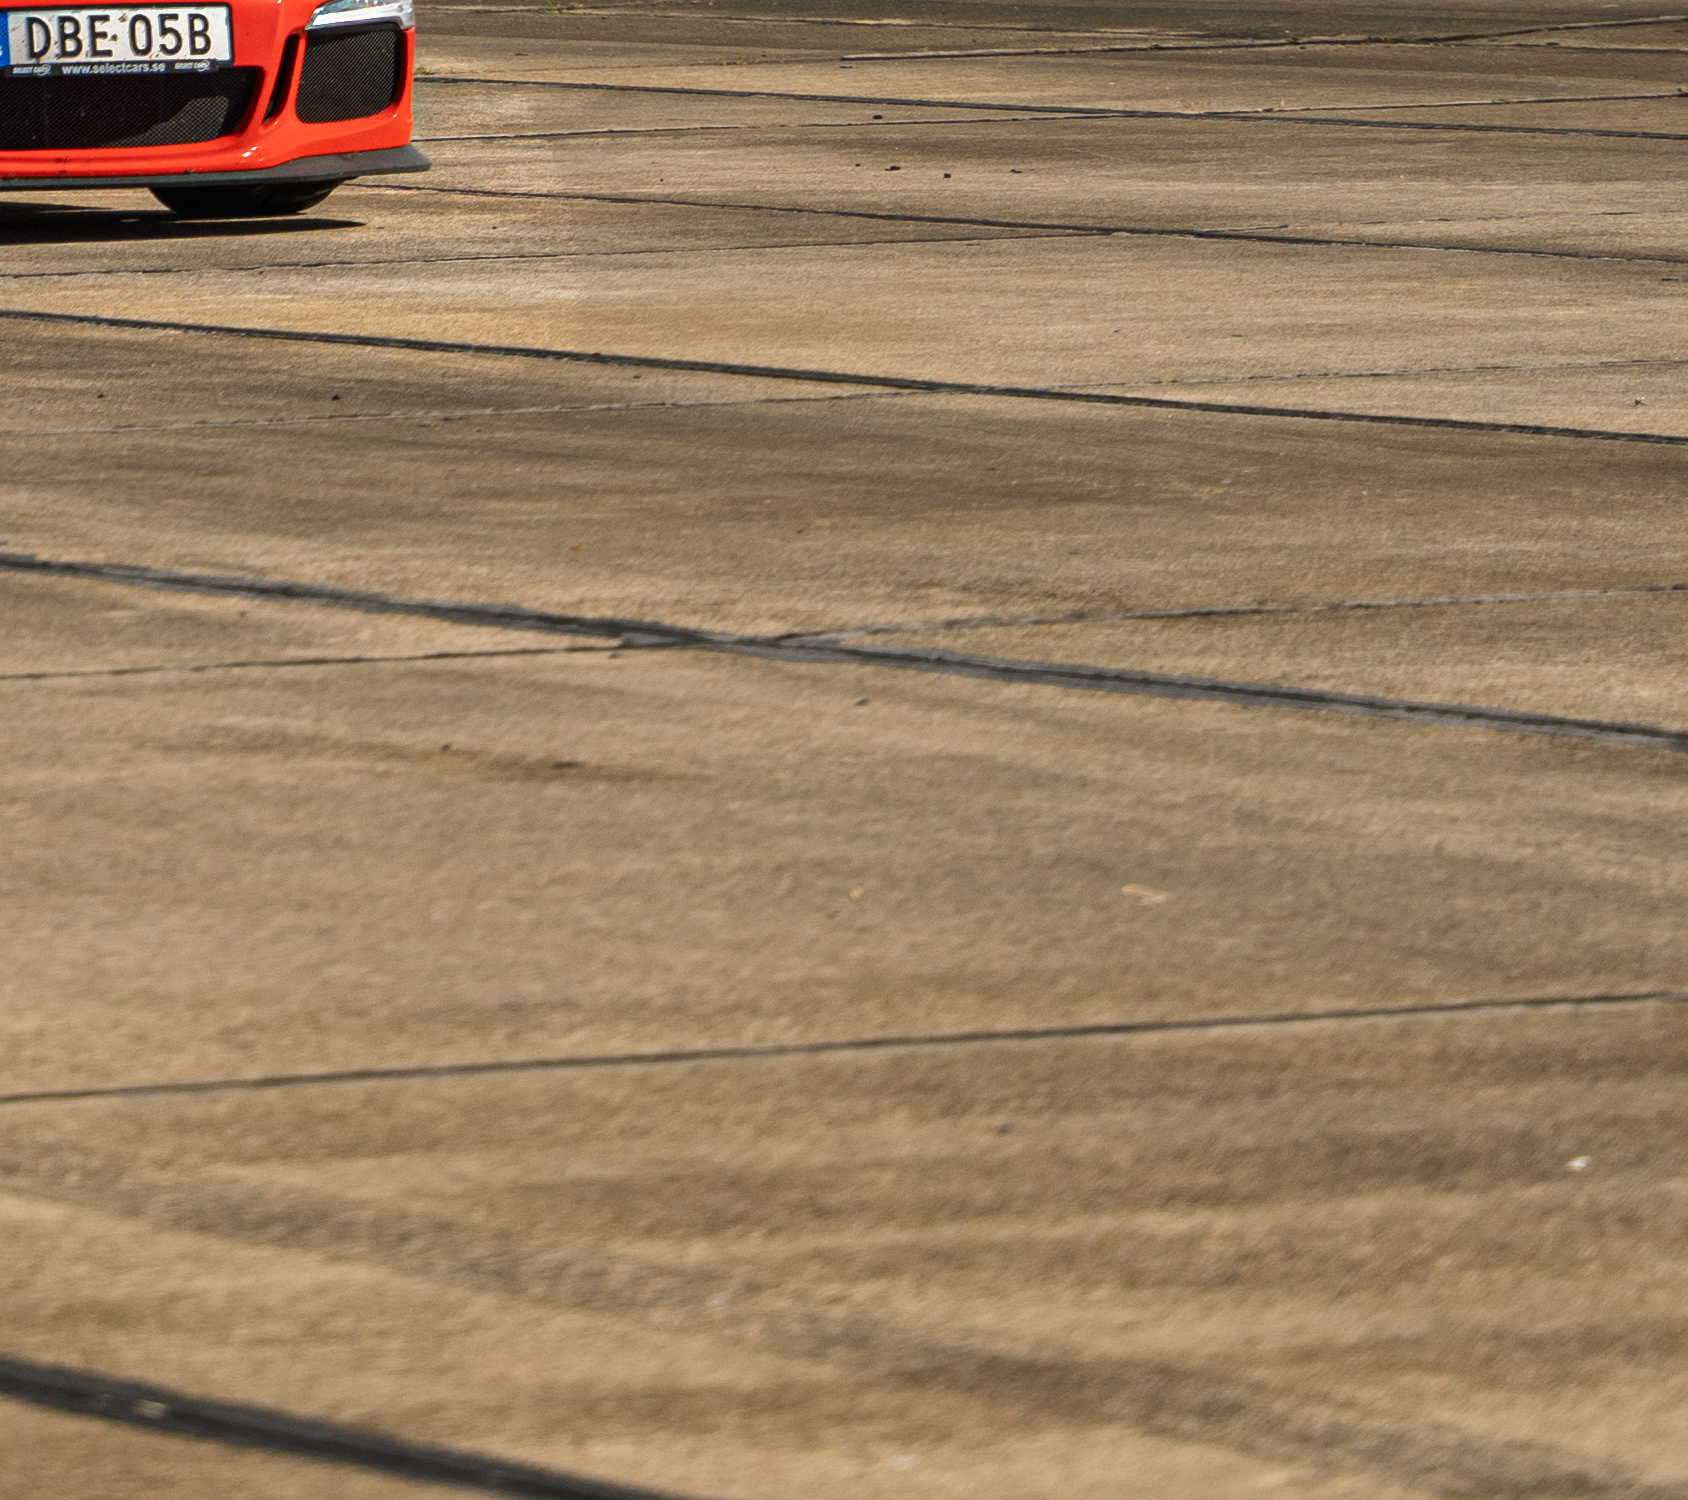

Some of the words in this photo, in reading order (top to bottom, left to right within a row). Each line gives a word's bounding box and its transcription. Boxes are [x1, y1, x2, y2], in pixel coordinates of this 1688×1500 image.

[26, 14, 114, 59] DBE
[128, 12, 212, 57] 05B
[61, 62, 166, 76] www.selectcars.se
